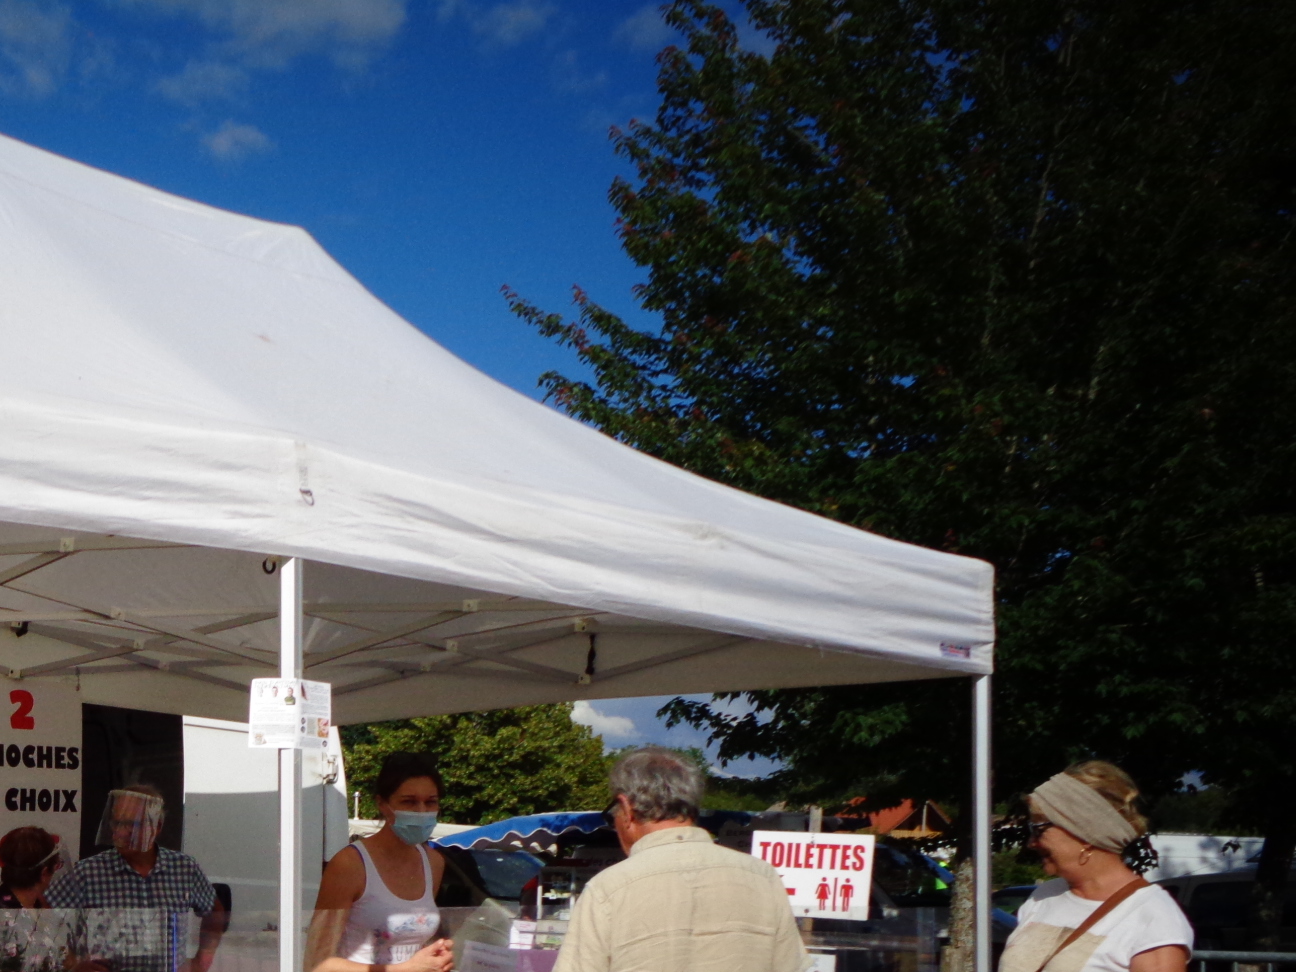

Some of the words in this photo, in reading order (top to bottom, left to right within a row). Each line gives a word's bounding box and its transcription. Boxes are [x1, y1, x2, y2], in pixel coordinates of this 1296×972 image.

[9, 690, 35, 730] 2
[5, 788, 77, 812] CHOIX
[760, 842, 865, 871] TOILETTES
